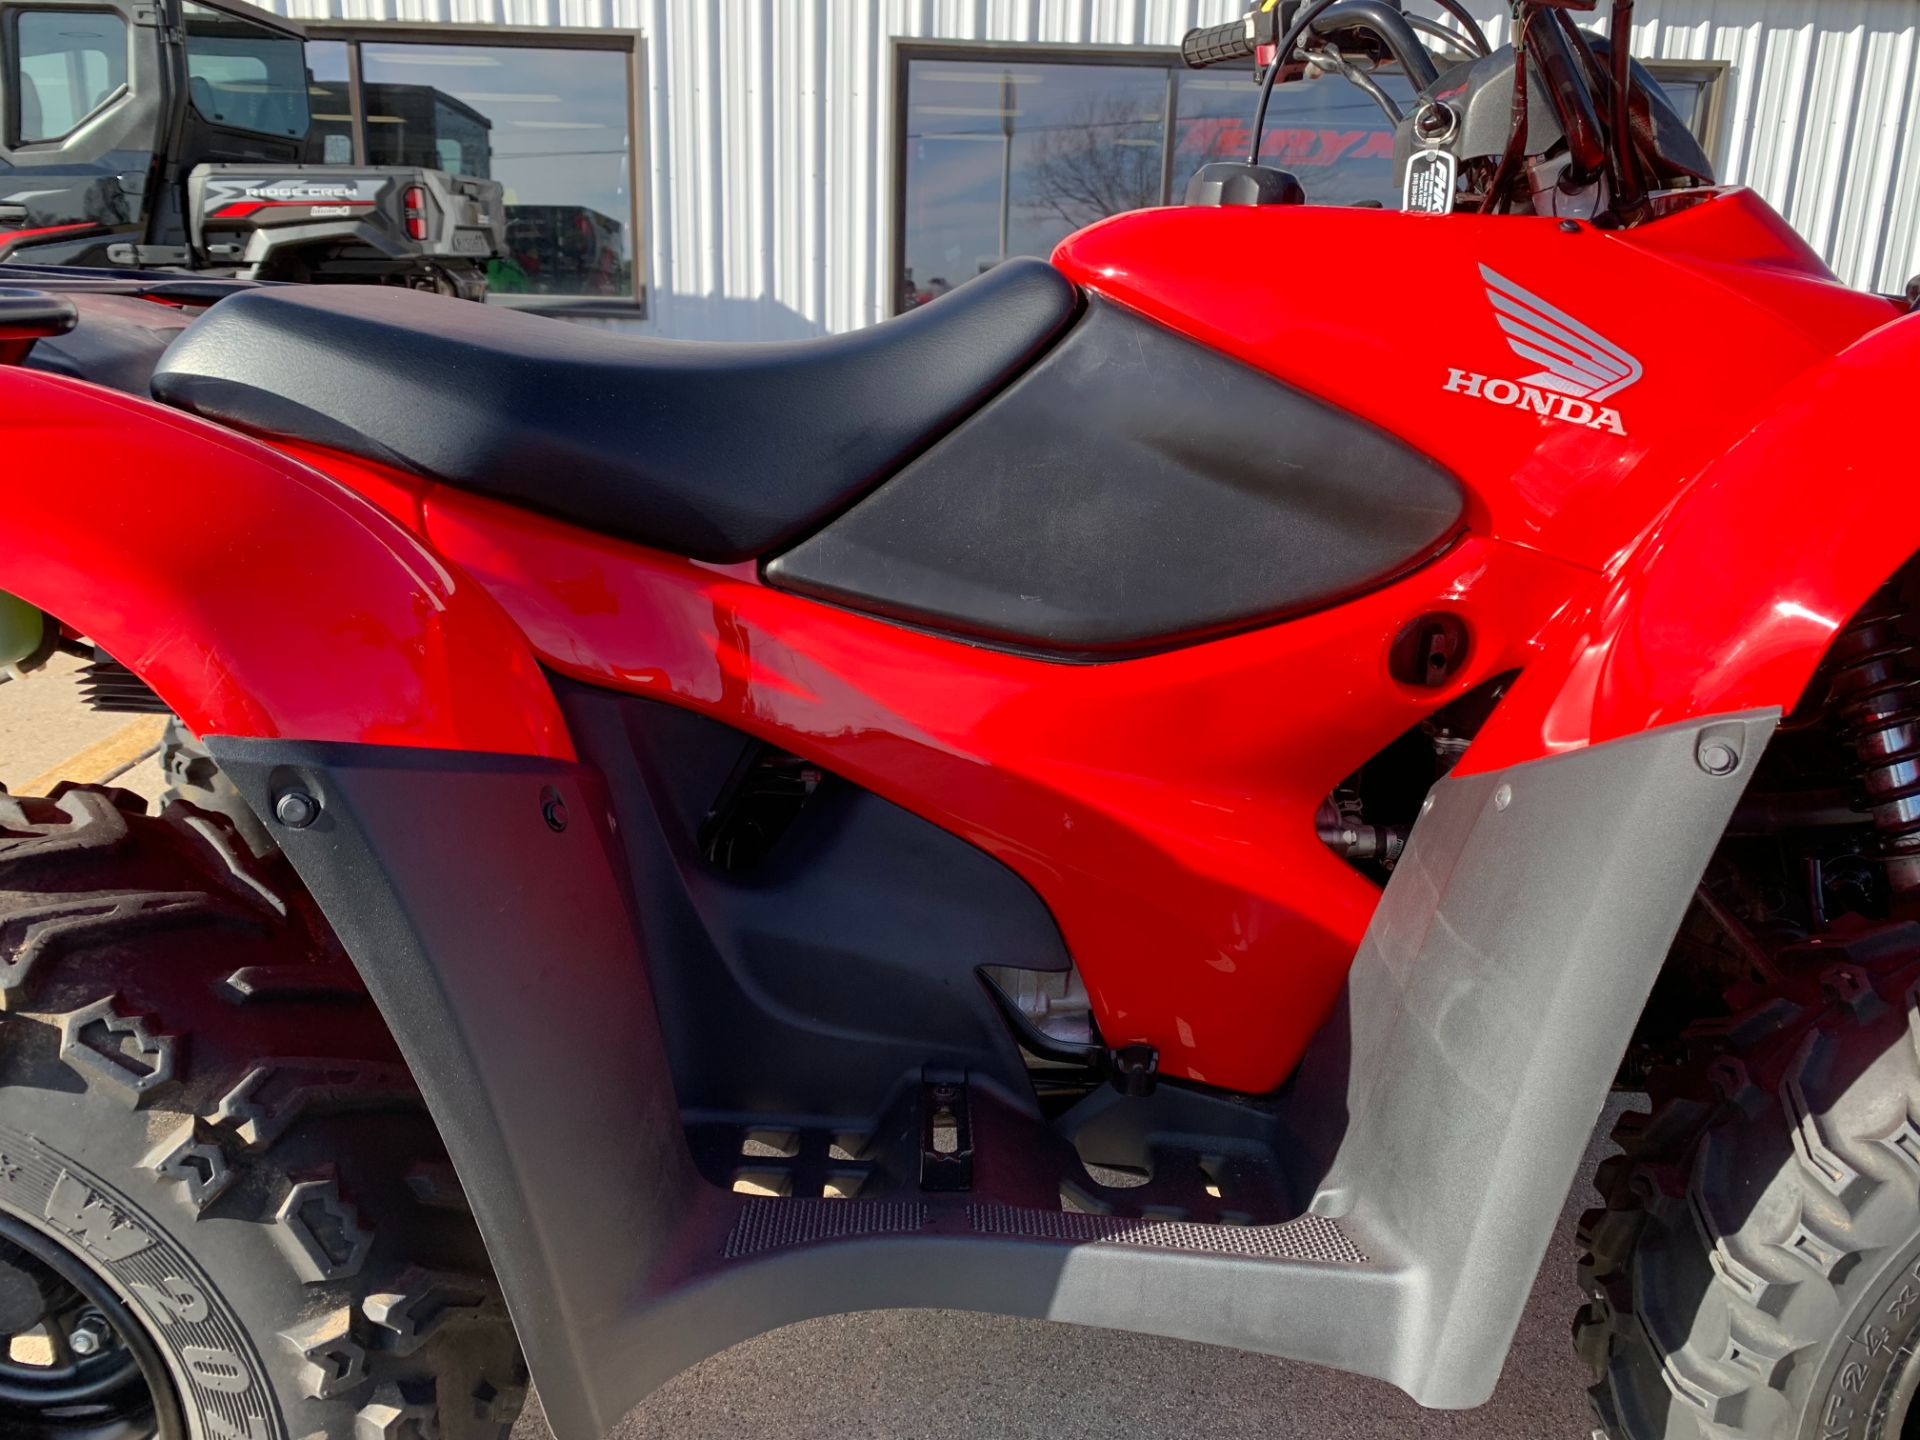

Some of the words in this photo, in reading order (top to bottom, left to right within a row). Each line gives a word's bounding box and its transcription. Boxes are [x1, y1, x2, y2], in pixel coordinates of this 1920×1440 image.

[245, 187, 302, 197] RIDGE
[307, 187, 357, 197] CREW
[1432, 160, 1447, 212] FHK
[1443, 367, 1628, 436] HONDA
